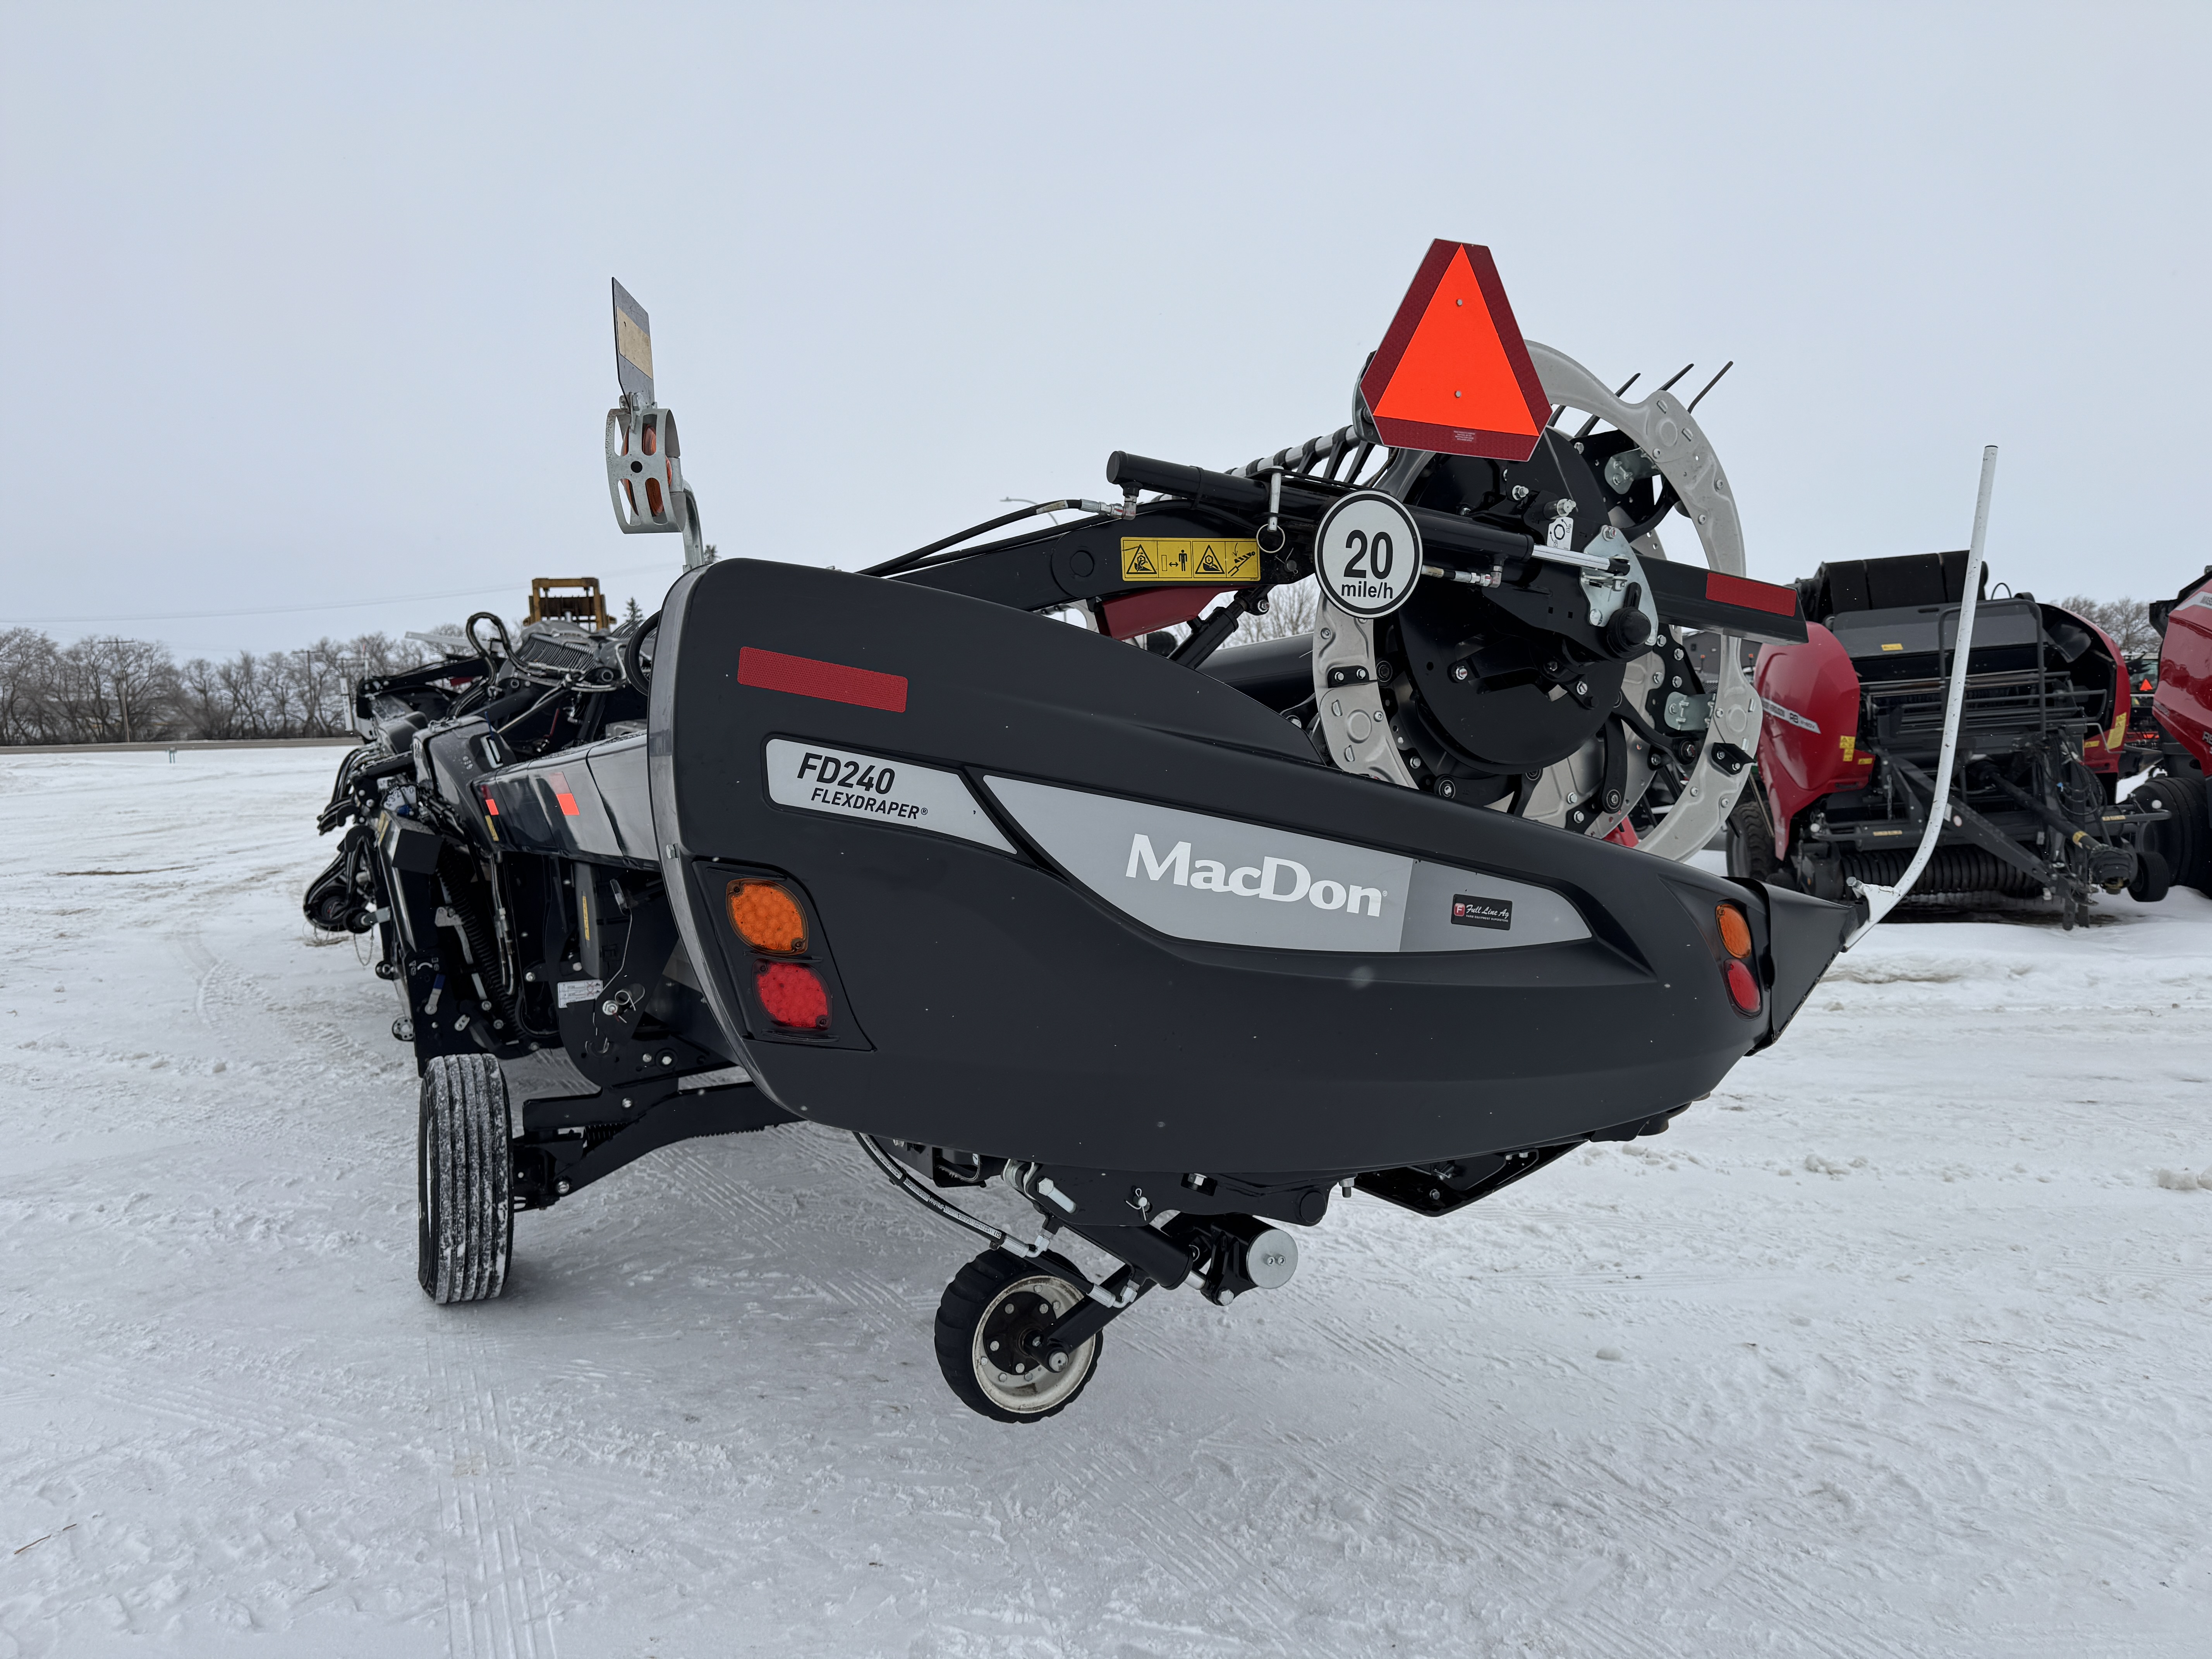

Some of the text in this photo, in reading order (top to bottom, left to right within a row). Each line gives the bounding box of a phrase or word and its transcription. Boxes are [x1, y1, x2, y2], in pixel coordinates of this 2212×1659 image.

[1344, 529, 1393, 579] 20
[1341, 581, 1393, 599] mile/h
[797, 752, 895, 795] FD240
[1466, 904, 1509, 919] Full Line Ag
